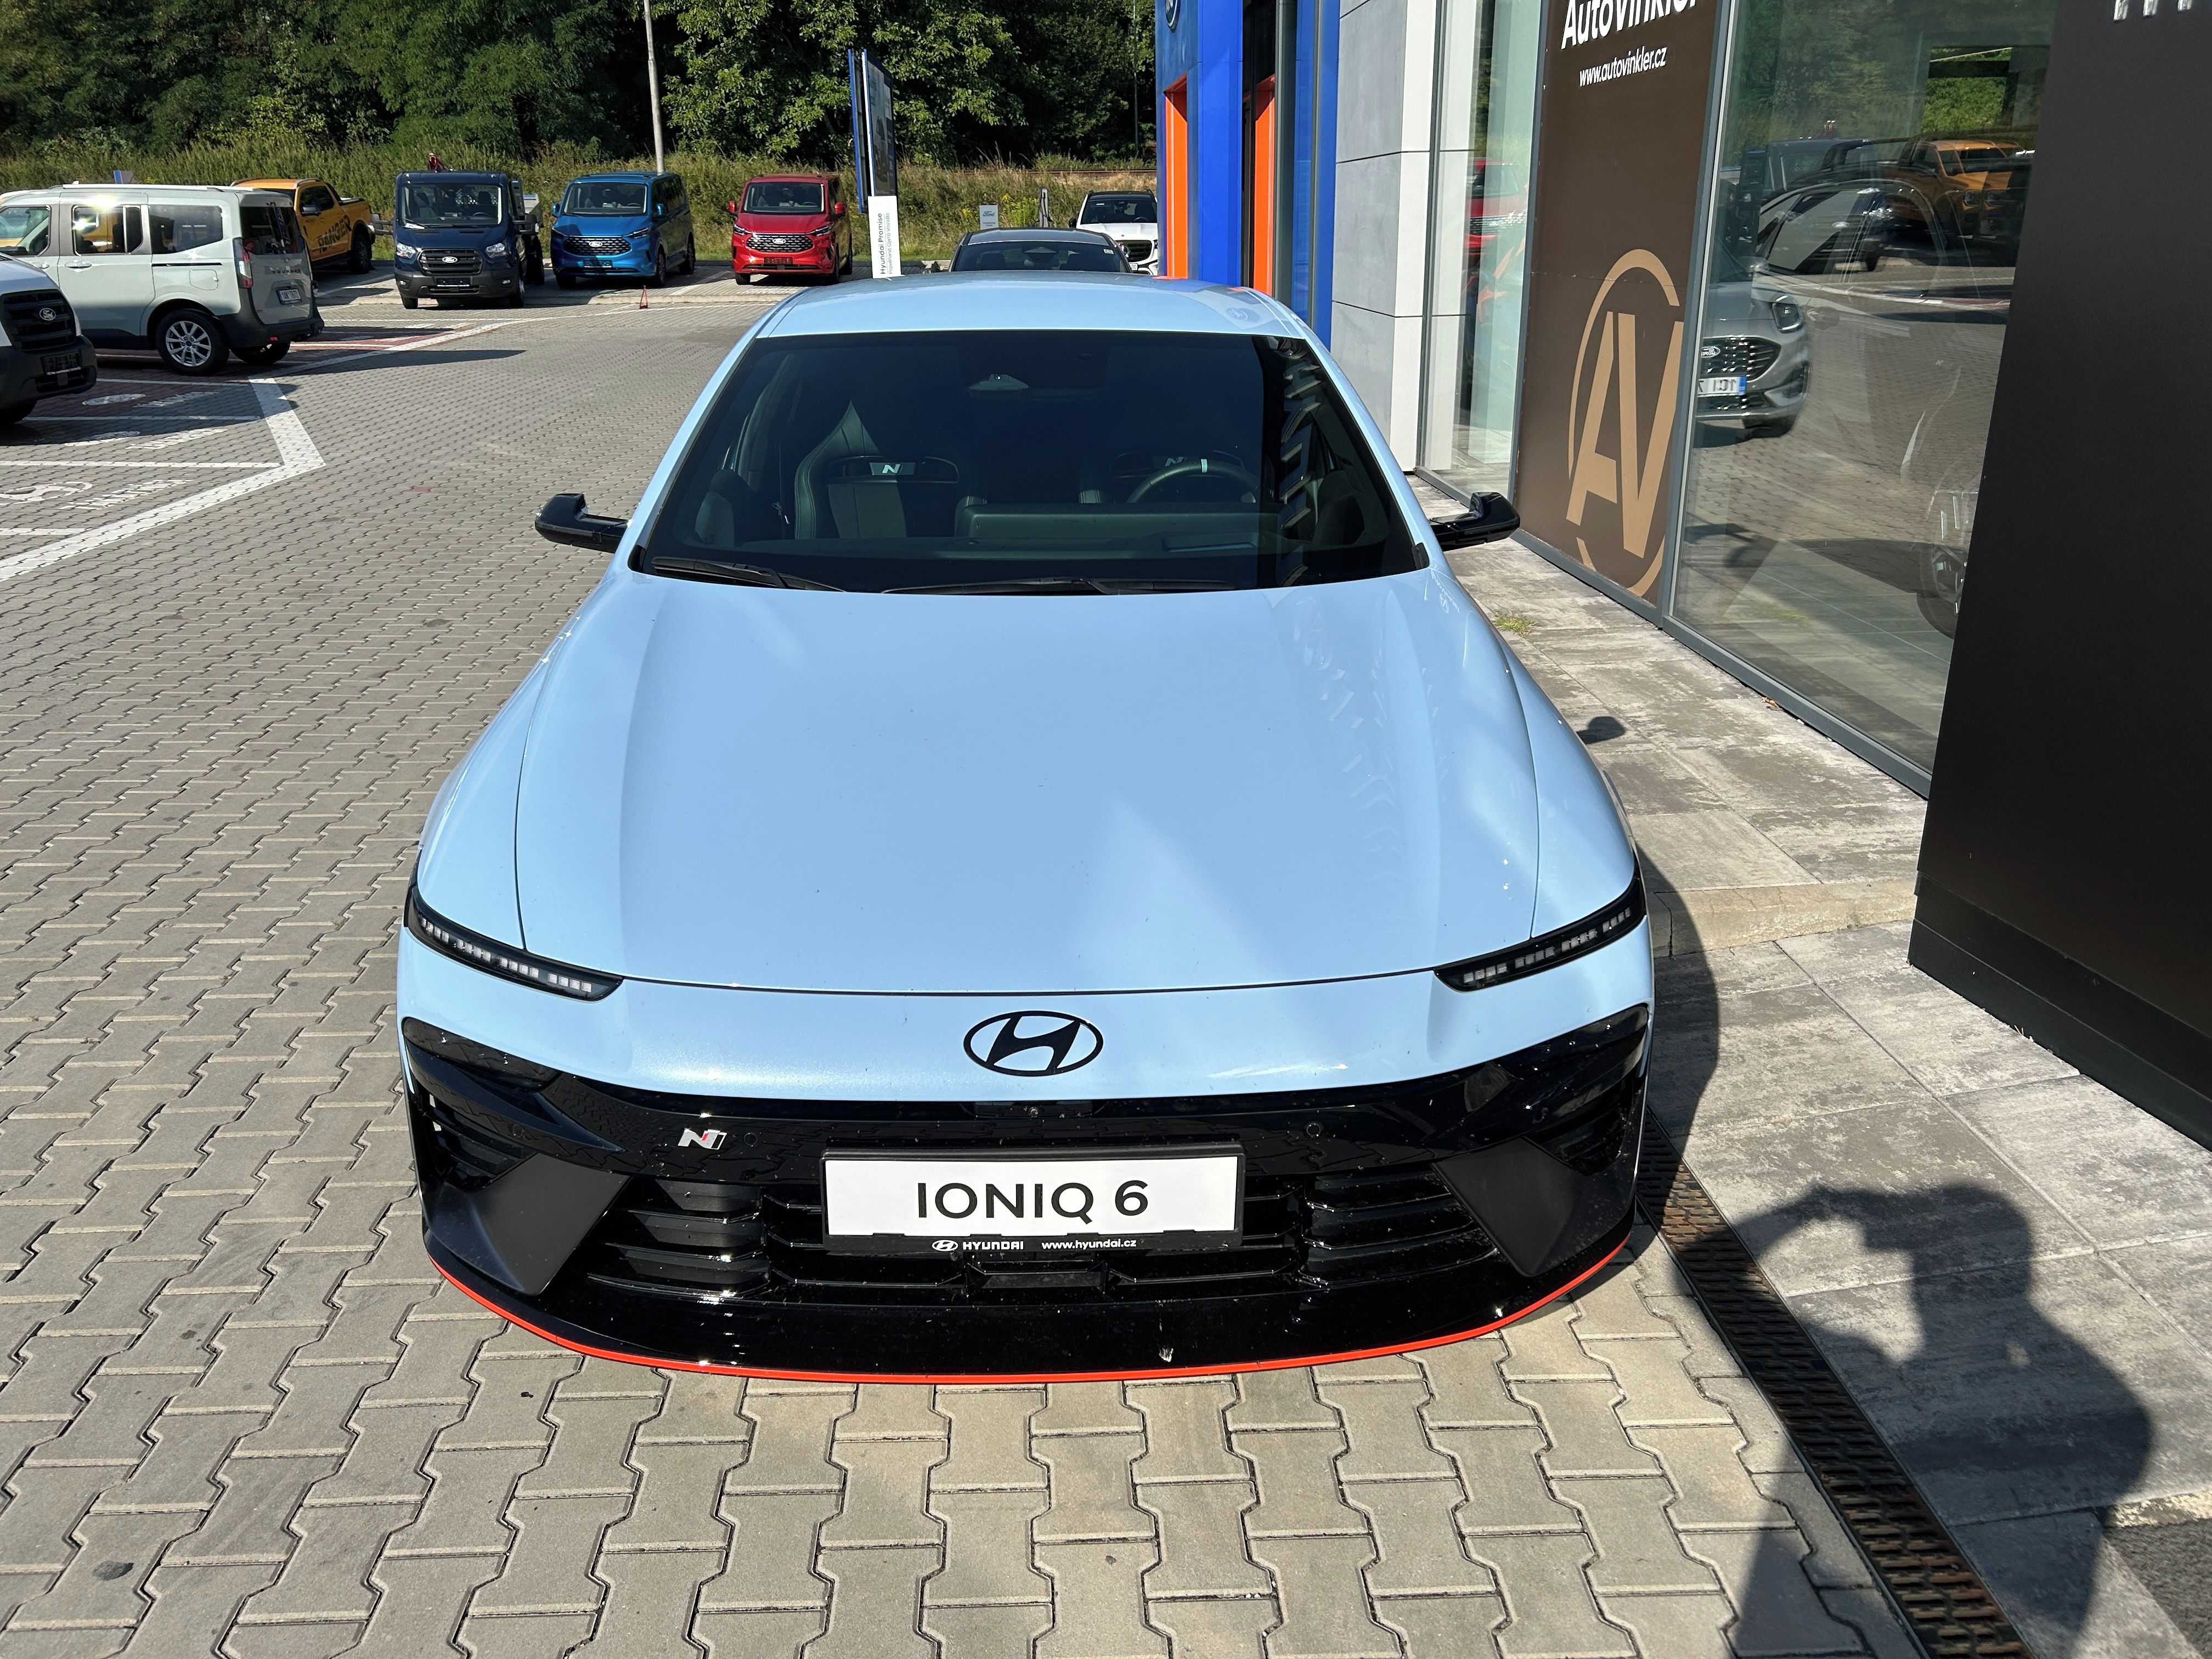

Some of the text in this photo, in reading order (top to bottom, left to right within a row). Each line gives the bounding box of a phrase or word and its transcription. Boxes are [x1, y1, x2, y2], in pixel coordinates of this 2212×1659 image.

[1579, 46, 1667, 87] www.autovinkler.cz
[318, 215, 352, 253] RANGER
[878, 244, 887, 274] Hyundai
[882, 464, 900, 473] N
[678, 1128, 727, 1150] N
[918, 1180, 1148, 1224] IONIQ 6
[963, 1240, 1024, 1250] HYUNDAI
[1042, 1238, 1137, 1250] www.hyundai.cz
